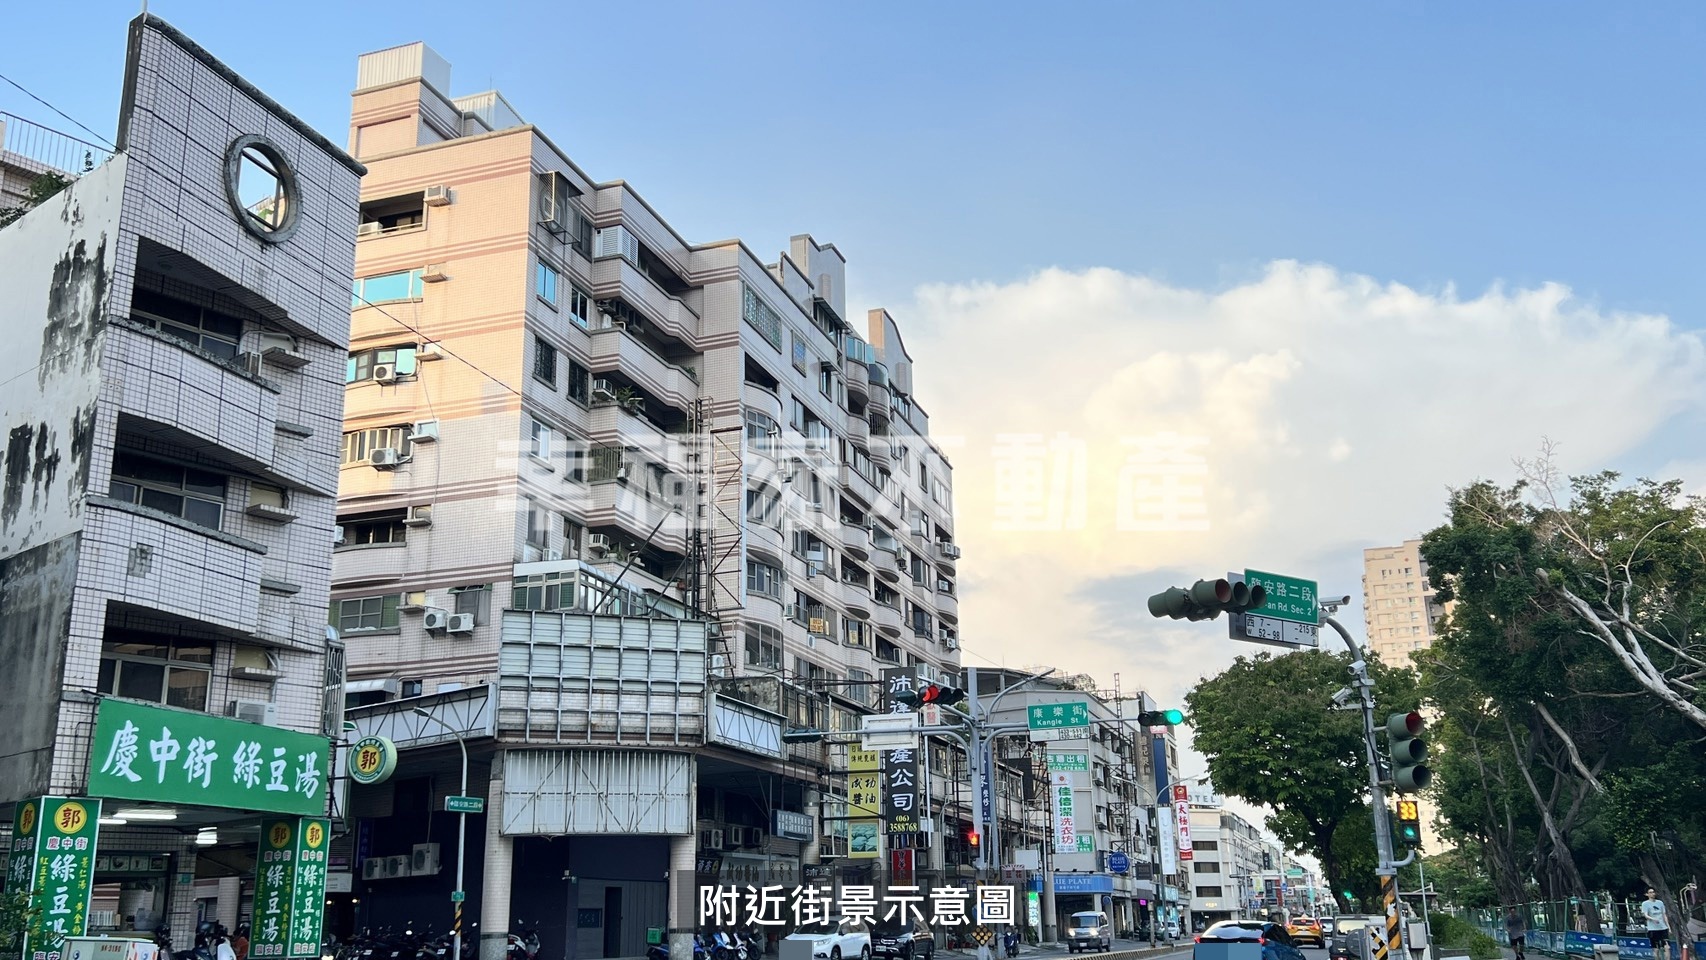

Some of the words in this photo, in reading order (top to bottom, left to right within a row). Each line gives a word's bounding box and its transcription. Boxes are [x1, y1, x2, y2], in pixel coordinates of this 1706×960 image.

[1277, 602, 1289, 612] Rd.
[1290, 604, 1306, 615] Sec.
[1306, 608, 1312, 616] 2
[1246, 616, 1255, 627] 西
[1033, 705, 1083, 718] 康樂街
[101, 720, 219, 789] 慶中街
[232, 740, 321, 799] 綠豆湯
[360, 749, 377, 770] 郭
[851, 777, 877, 790] 成功
[852, 792, 877, 805] 醬油
[1189, 794, 1216, 804] OTEL
[61, 807, 81, 829] 郭
[1400, 801, 1418, 820] 33
[46, 836, 88, 850] 慶中街
[273, 826, 287, 844] 郭
[309, 827, 320, 844] 郭
[44, 854, 77, 948] 綠豆湯
[262, 864, 284, 941] 綠豆湯
[300, 864, 319, 941] 綠豆湯
